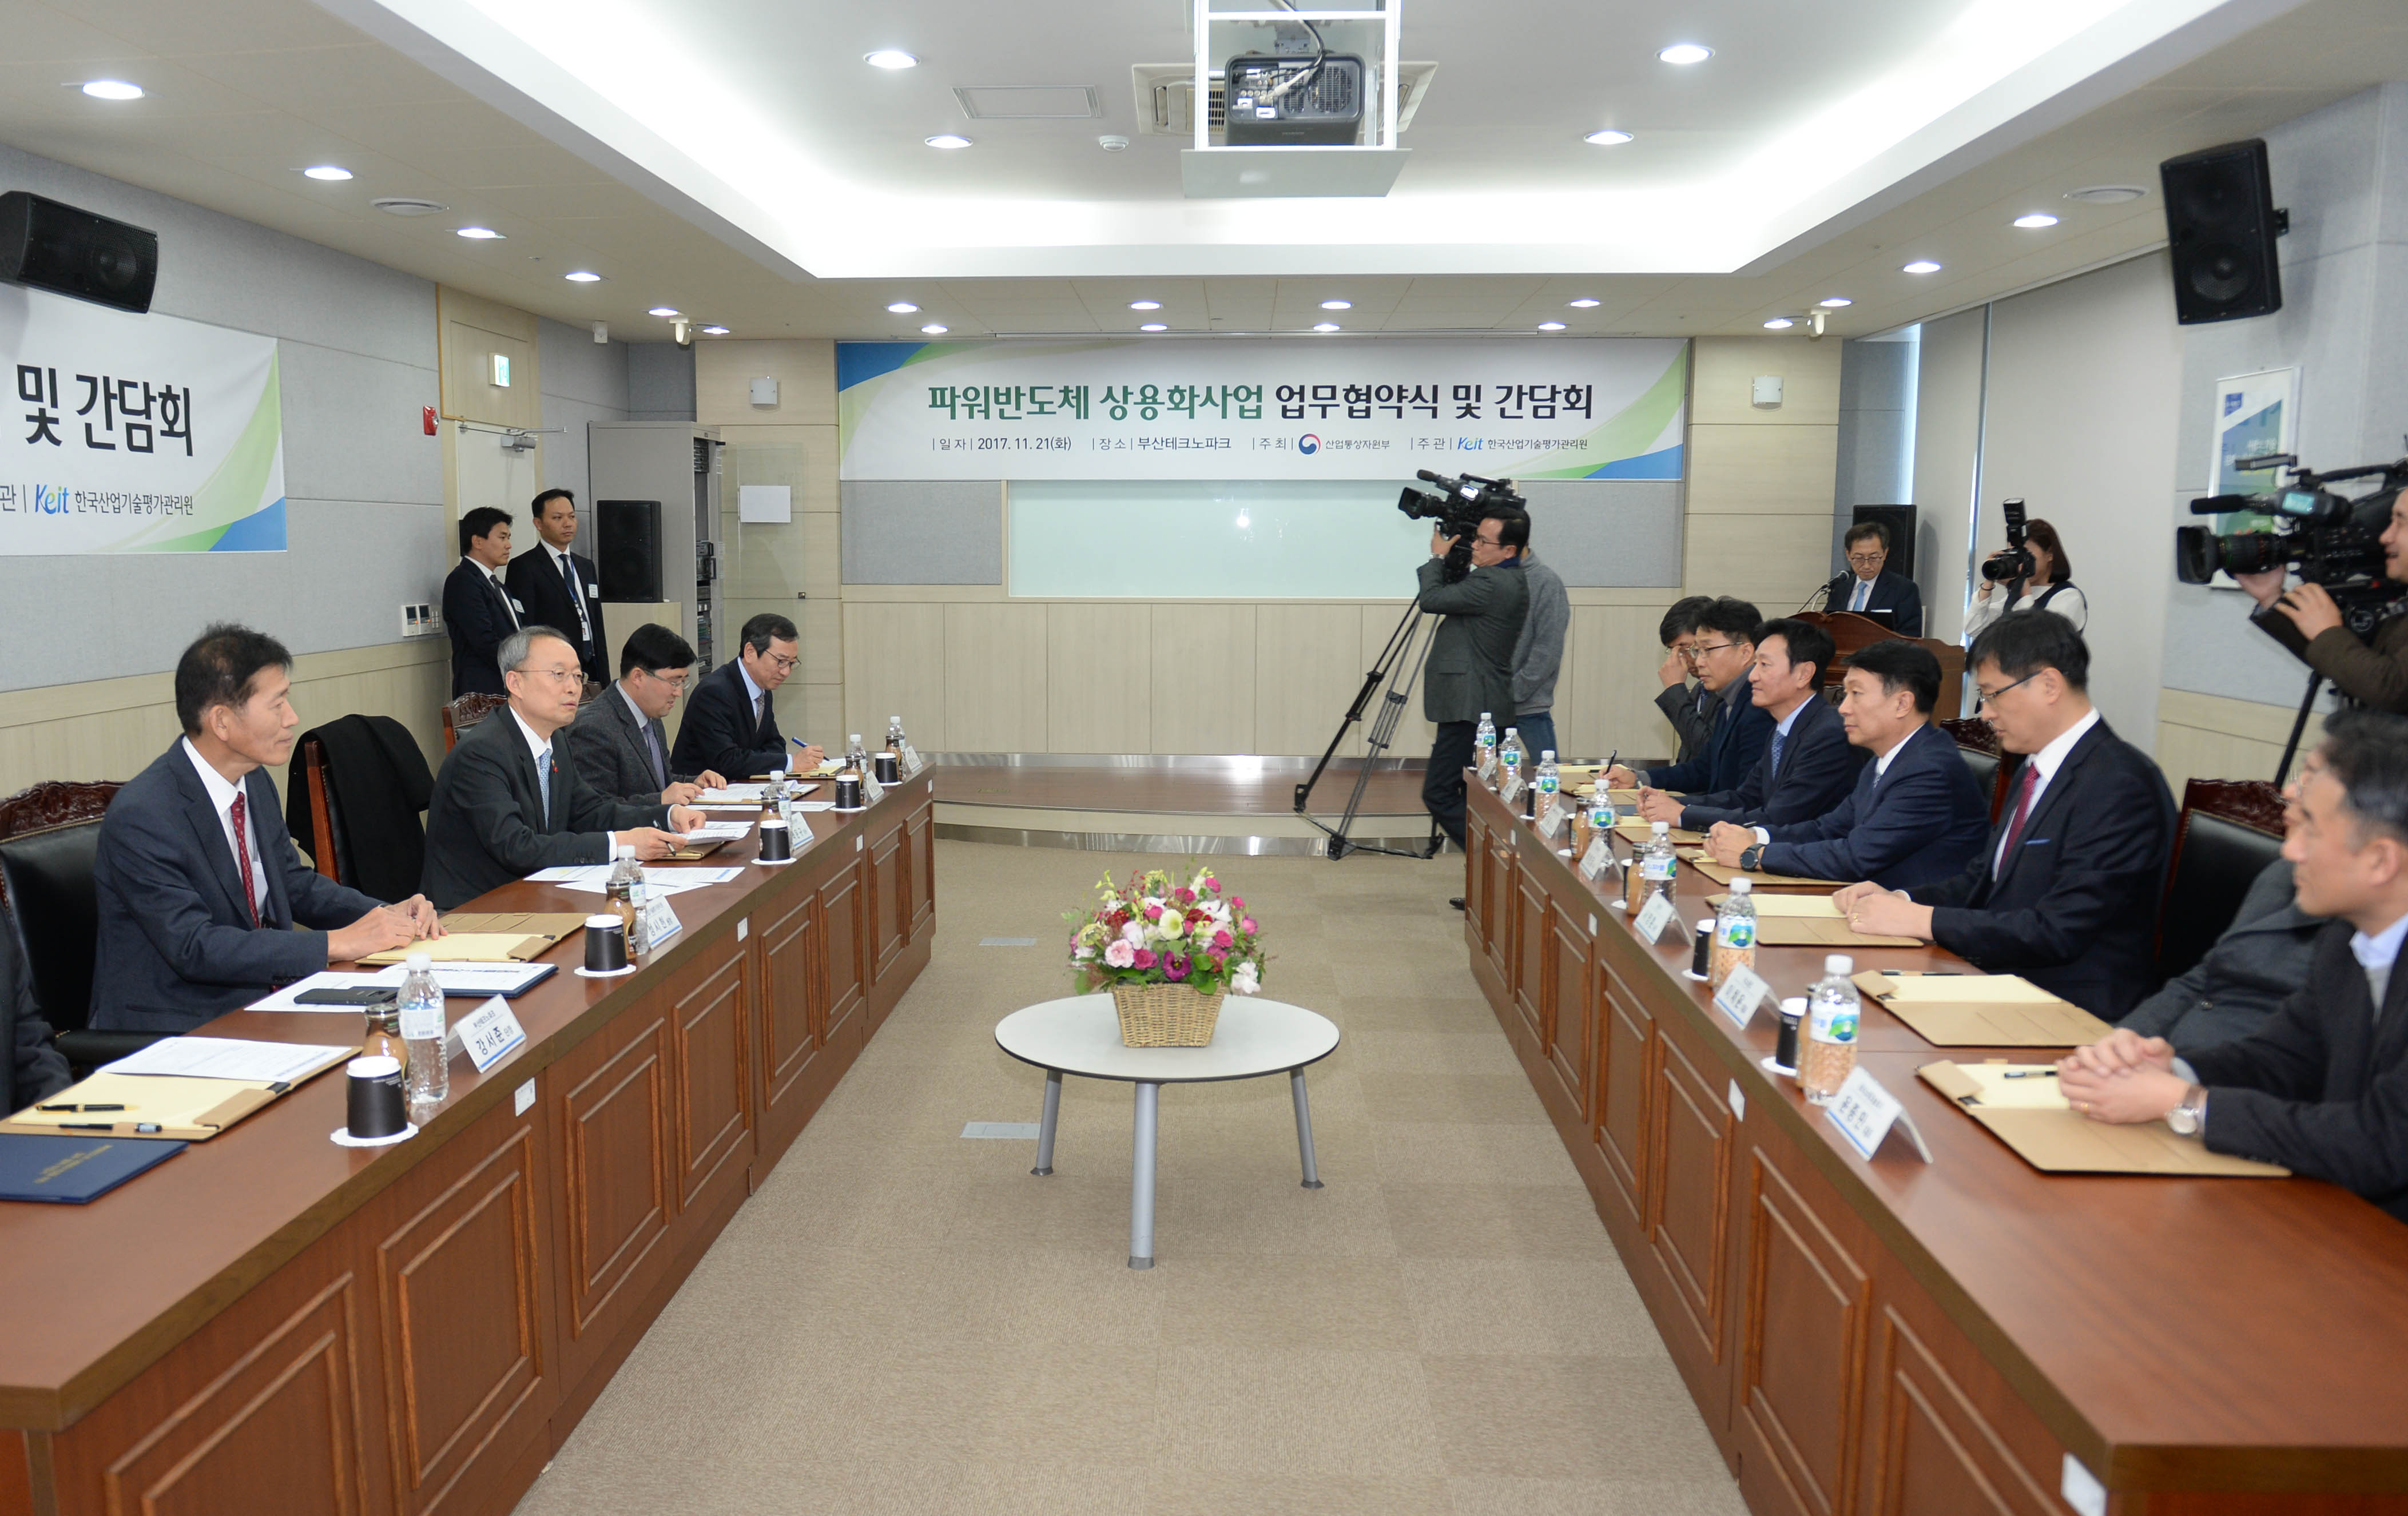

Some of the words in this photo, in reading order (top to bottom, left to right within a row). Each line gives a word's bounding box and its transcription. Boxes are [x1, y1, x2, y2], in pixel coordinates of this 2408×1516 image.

[928, 385, 1088, 420] 파워반도체
[1099, 384, 1262, 420] 상용화사업
[1275, 384, 1439, 419] 업무협약식
[1453, 385, 1481, 419] 및
[1495, 384, 1592, 419] 간담회
[17, 364, 62, 447] 및
[76, 374, 193, 456] 간담회
[1036, 436, 1071, 451] 21(화)
[1138, 437, 1231, 450] 부산테크노파크
[1326, 440, 1390, 449] 산업통상자원부
[1457, 437, 1484, 450] Keit
[1488, 439, 1587, 449] 한국산업기술평가관리원
[35, 484, 69, 515] Keit
[74, 491, 193, 515] 한국산업기술평가관리원
